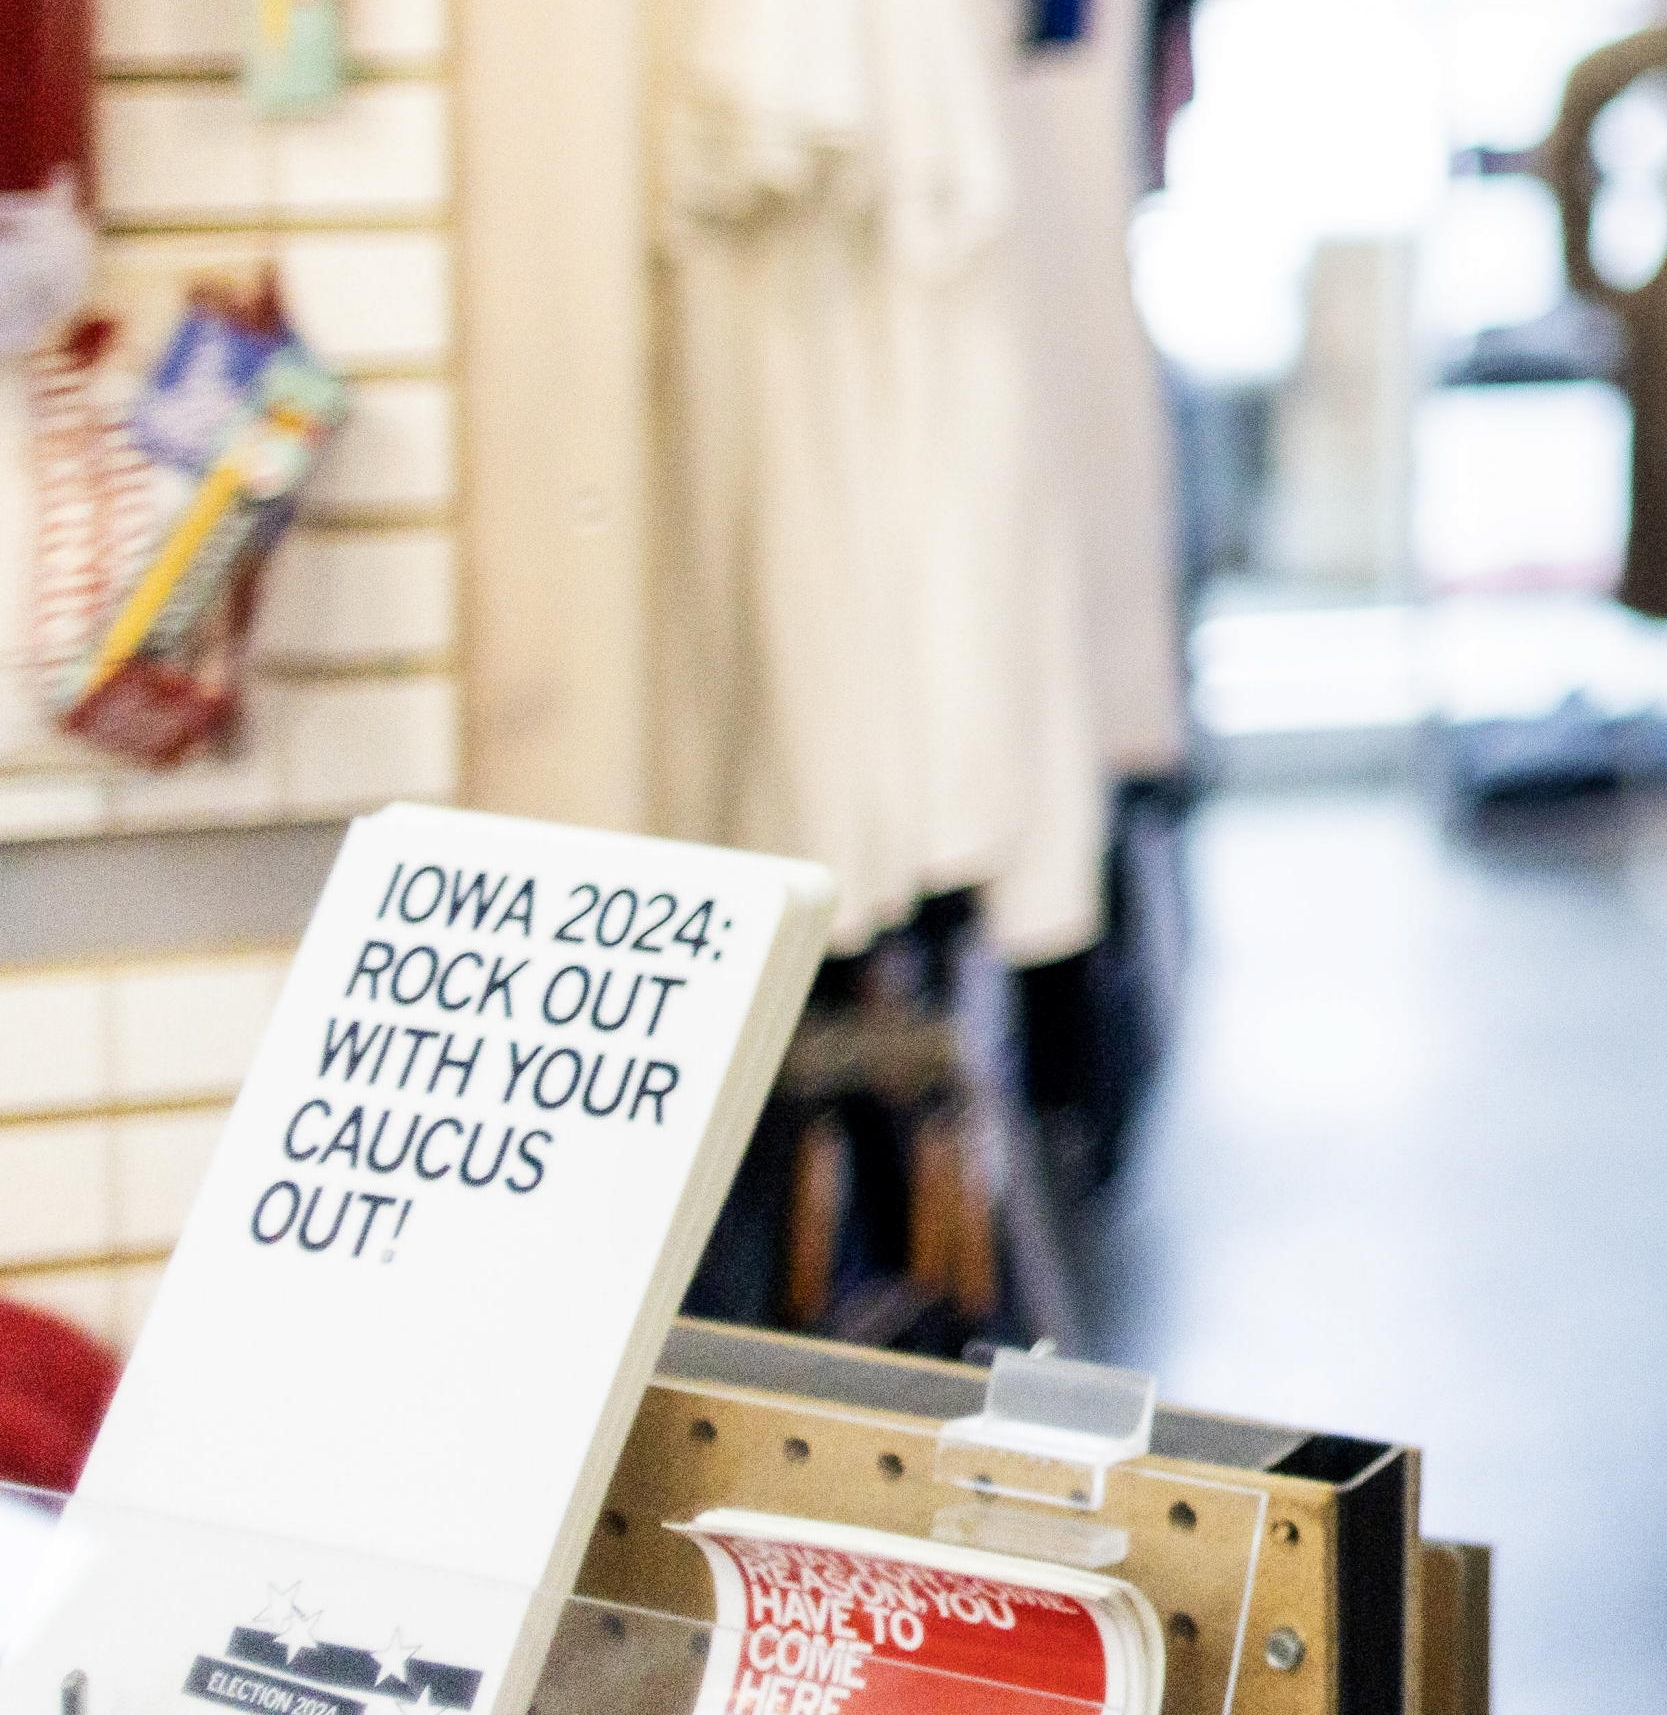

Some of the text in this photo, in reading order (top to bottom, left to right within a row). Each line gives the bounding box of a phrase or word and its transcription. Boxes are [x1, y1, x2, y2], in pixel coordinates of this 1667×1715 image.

[376, 860, 735, 963] IOWA 2024:
[345, 940, 685, 1038] ROCK OUT
[317, 1016, 681, 1127] WITH YOUR
[283, 1097, 554, 1194] CAUCUS
[251, 1180, 413, 1264] OUT!
[751, 1583, 925, 1652] HAVE TO
[919, 1582, 1017, 1631] YOU
[205, 1670, 296, 1714] ELECTION
[732, 1668, 853, 1715] HERE
[750, 1623, 874, 1690] COME
